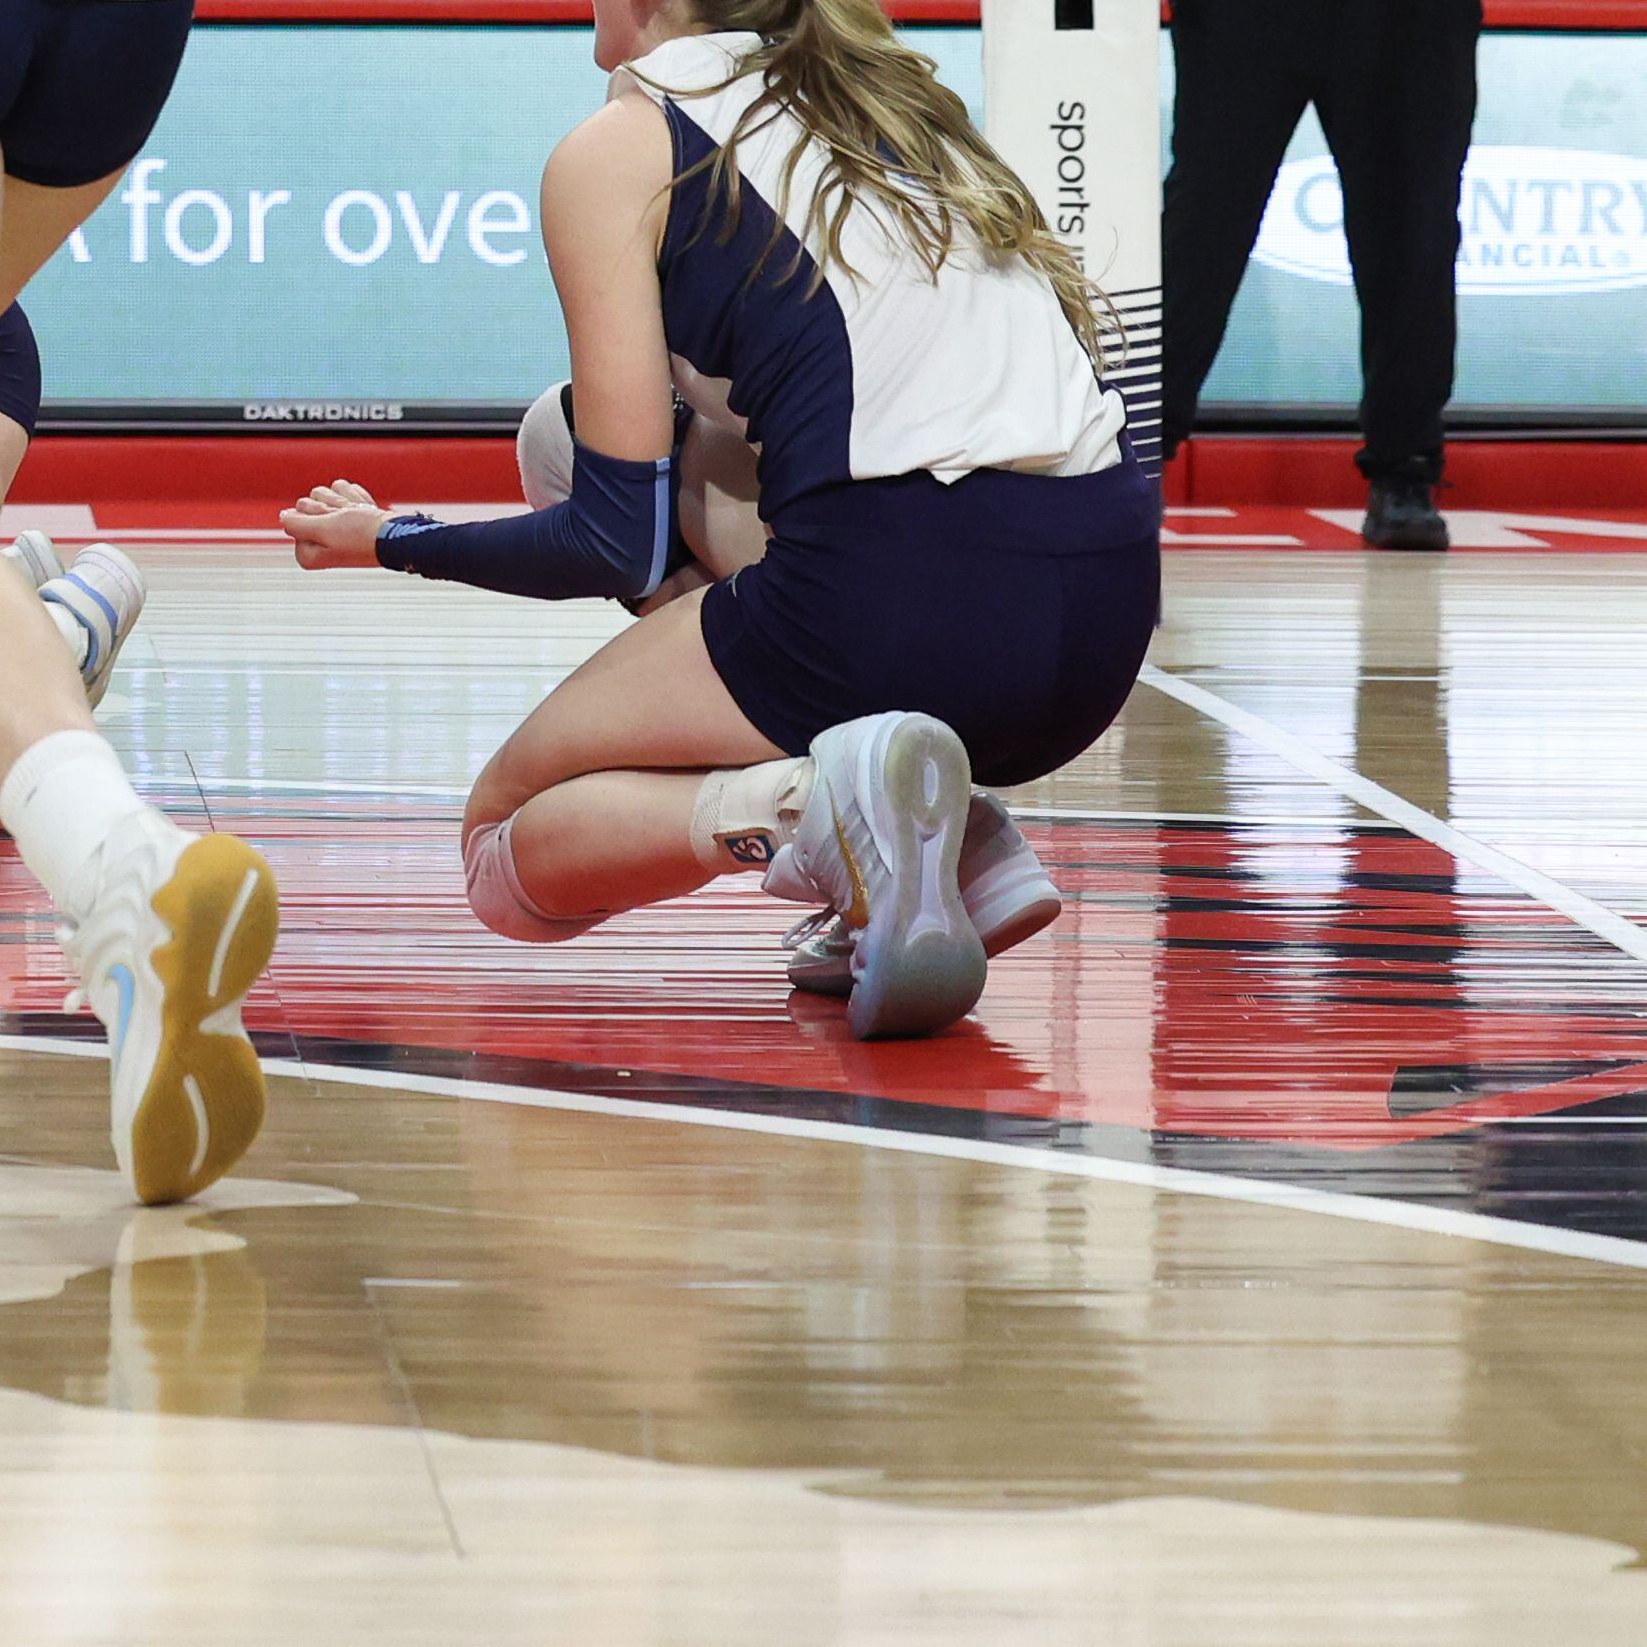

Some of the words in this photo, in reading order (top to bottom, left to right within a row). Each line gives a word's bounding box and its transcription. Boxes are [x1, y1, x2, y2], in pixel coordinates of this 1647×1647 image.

[120, 158, 292, 267] for
[1050, 100, 1091, 234] sports
[243, 405, 404, 422] DAKTRONICS
